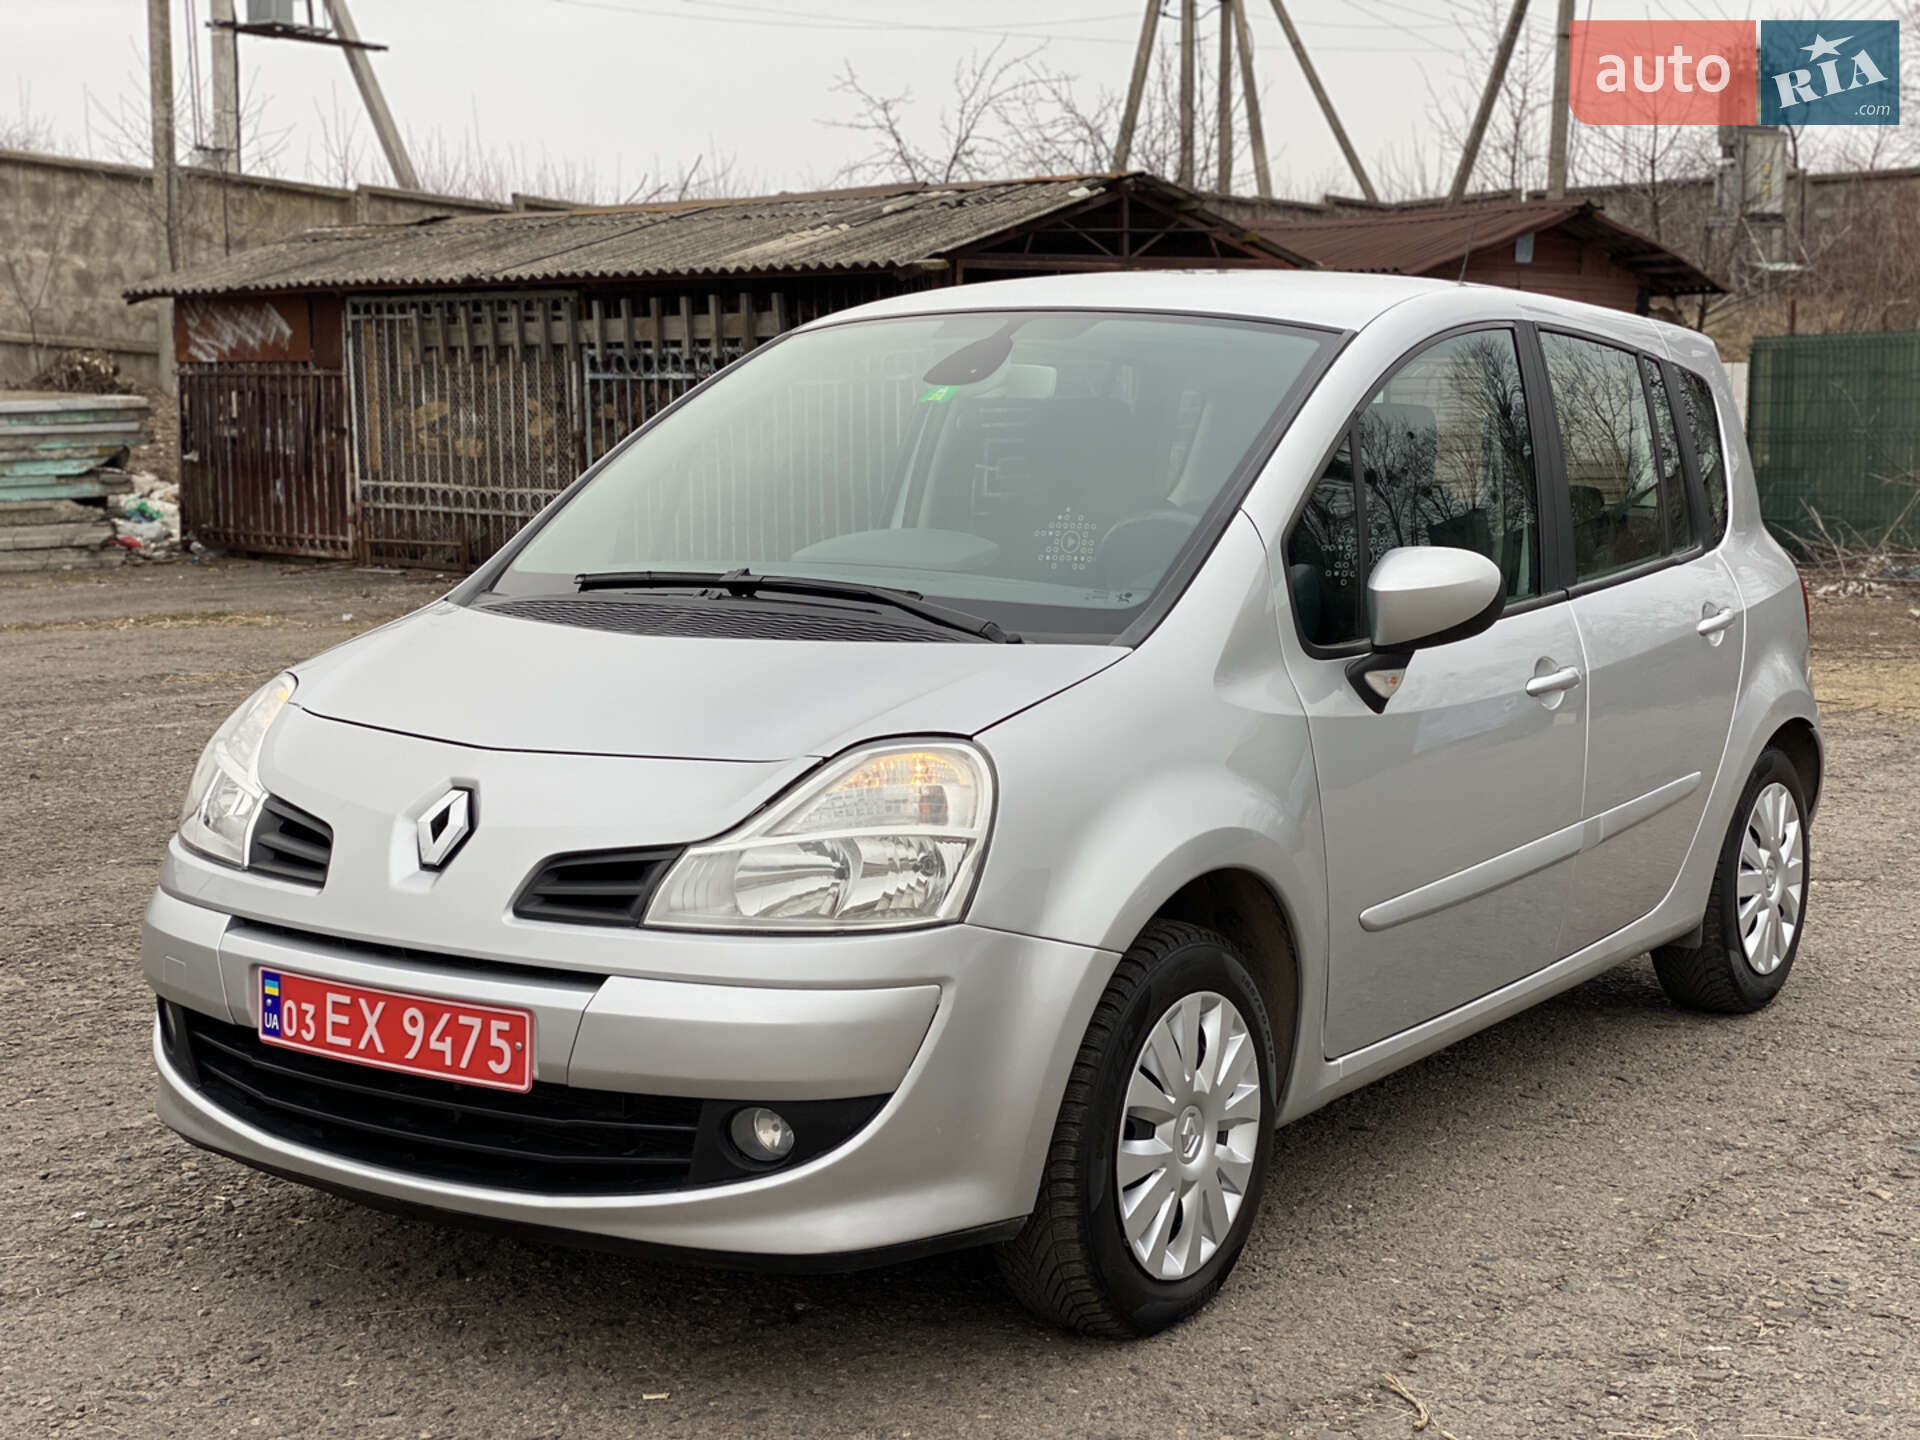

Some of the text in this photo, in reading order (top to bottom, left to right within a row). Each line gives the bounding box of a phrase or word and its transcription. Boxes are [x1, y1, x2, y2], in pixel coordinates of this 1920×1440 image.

[264, 1012, 280, 1030] UA
[283, 992, 511, 1075] 03 EX 9475
